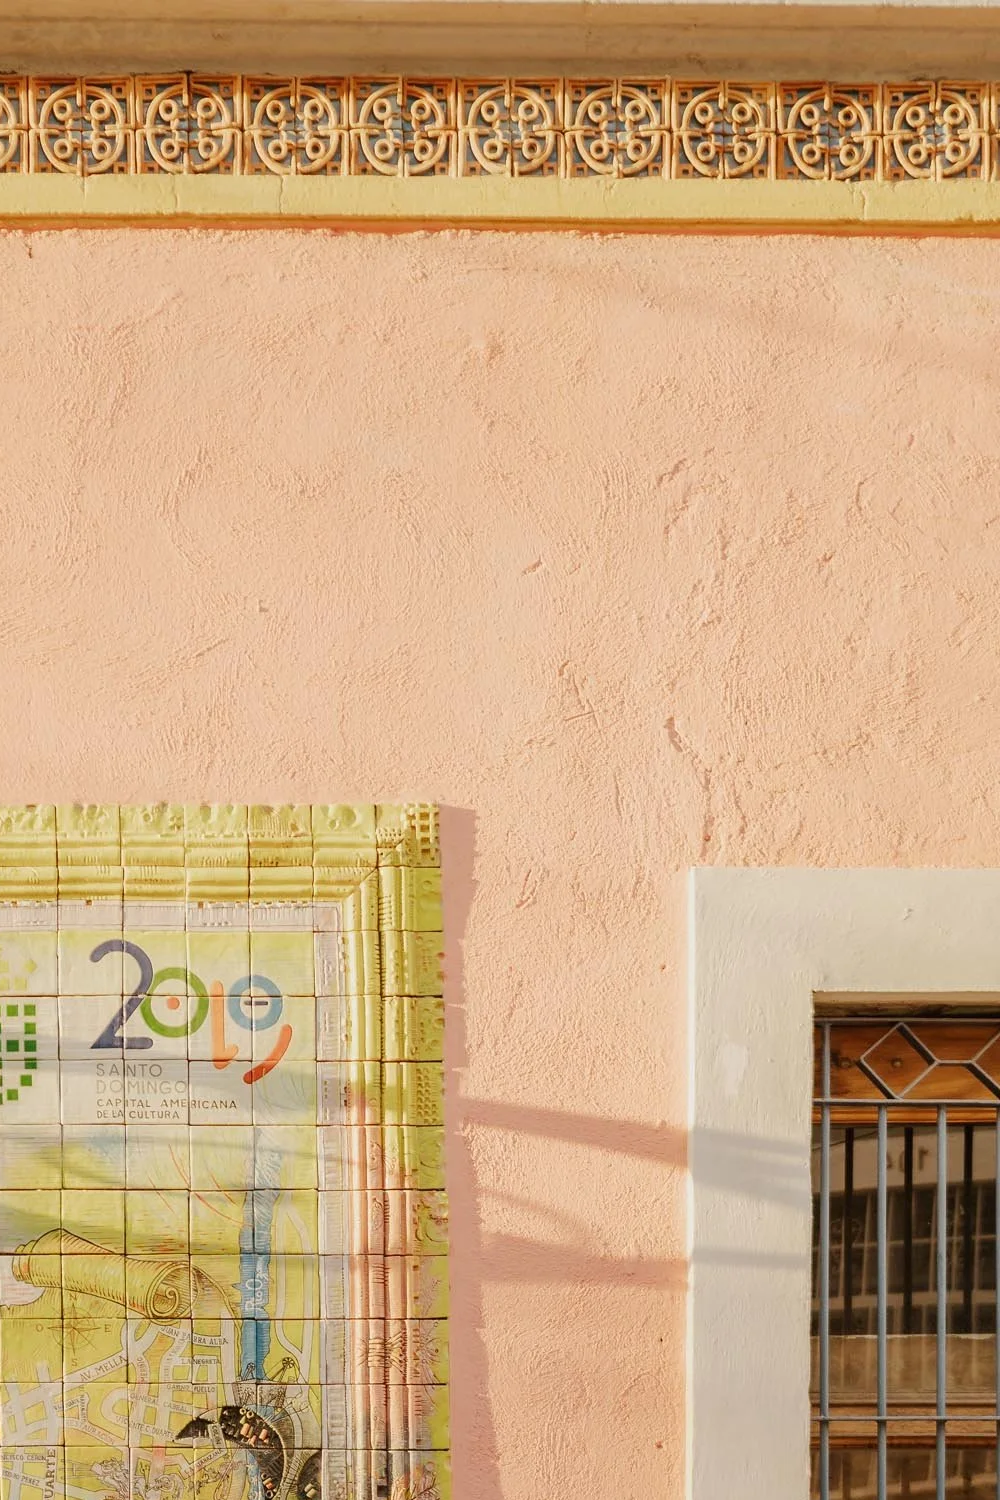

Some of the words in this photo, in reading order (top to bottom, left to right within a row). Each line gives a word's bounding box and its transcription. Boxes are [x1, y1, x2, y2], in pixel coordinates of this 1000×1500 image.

[89, 938, 293, 1085] 2019
[96, 1063, 162, 1078] SANTO
[96, 1079, 188, 1095] DOMINGO
[96, 1098, 151, 1108] CAPITAL
[160, 1098, 237, 1109] AMERICANA
[96, 1110, 108, 1119] DE
[112, 1109, 124, 1119] LA
[128, 1110, 180, 1119] CULTURA
[104, 1323, 111, 1332] E
[95, 1355, 127, 1374] MELLA
